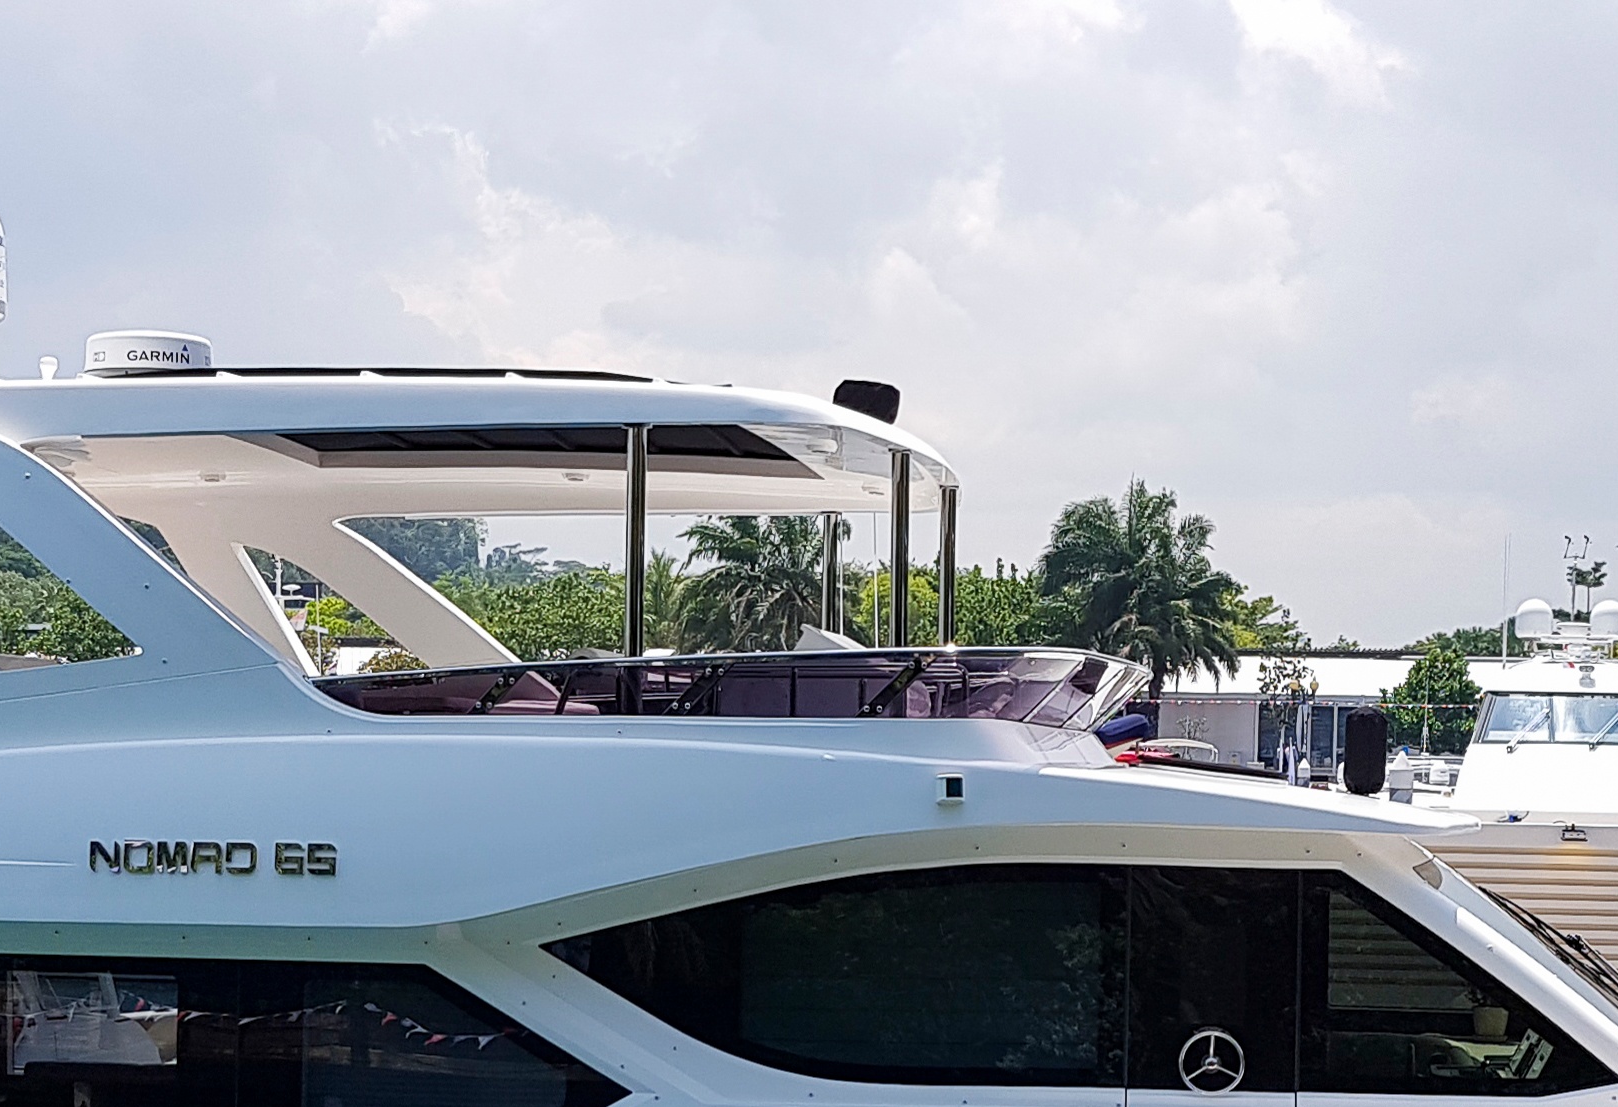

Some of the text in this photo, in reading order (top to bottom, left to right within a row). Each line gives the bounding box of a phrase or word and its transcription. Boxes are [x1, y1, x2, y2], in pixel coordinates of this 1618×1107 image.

[126, 349, 190, 365] GARMIN
[89, 839, 338, 877] NOMAD 65
